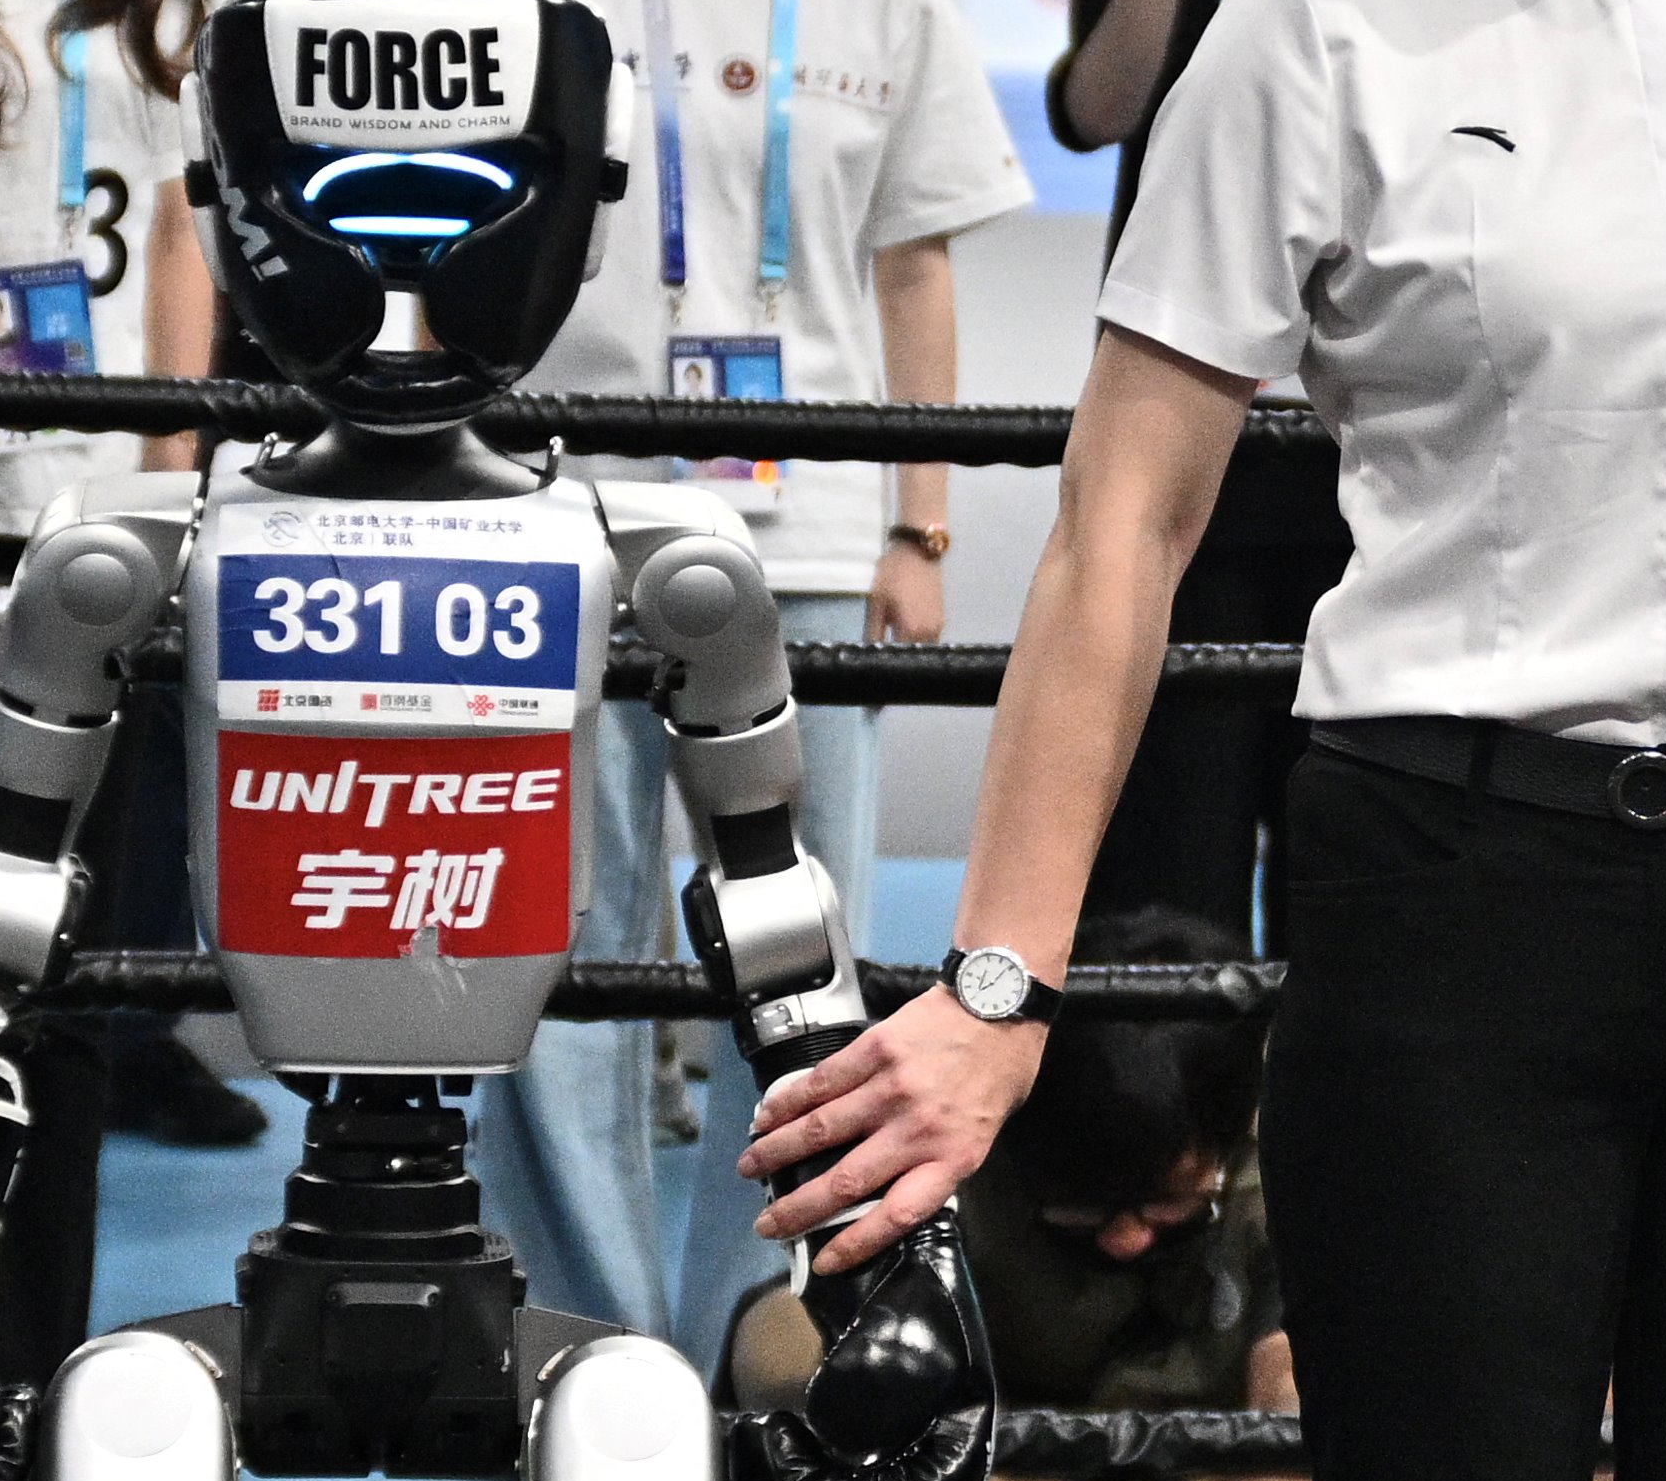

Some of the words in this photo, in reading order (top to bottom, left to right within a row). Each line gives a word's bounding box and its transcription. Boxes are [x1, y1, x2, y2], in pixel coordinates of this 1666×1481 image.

[295, 26, 504, 111] FORCE
[290, 115, 342, 129] BRAND
[349, 118, 412, 130] WISDOM
[418, 118, 452, 130] AND
[458, 114, 511, 130] CHARM
[252, 576, 403, 655] 331
[435, 583, 542, 660] 03
[229, 760, 562, 828] UNITREE
[290, 846, 505, 930] 宇树
